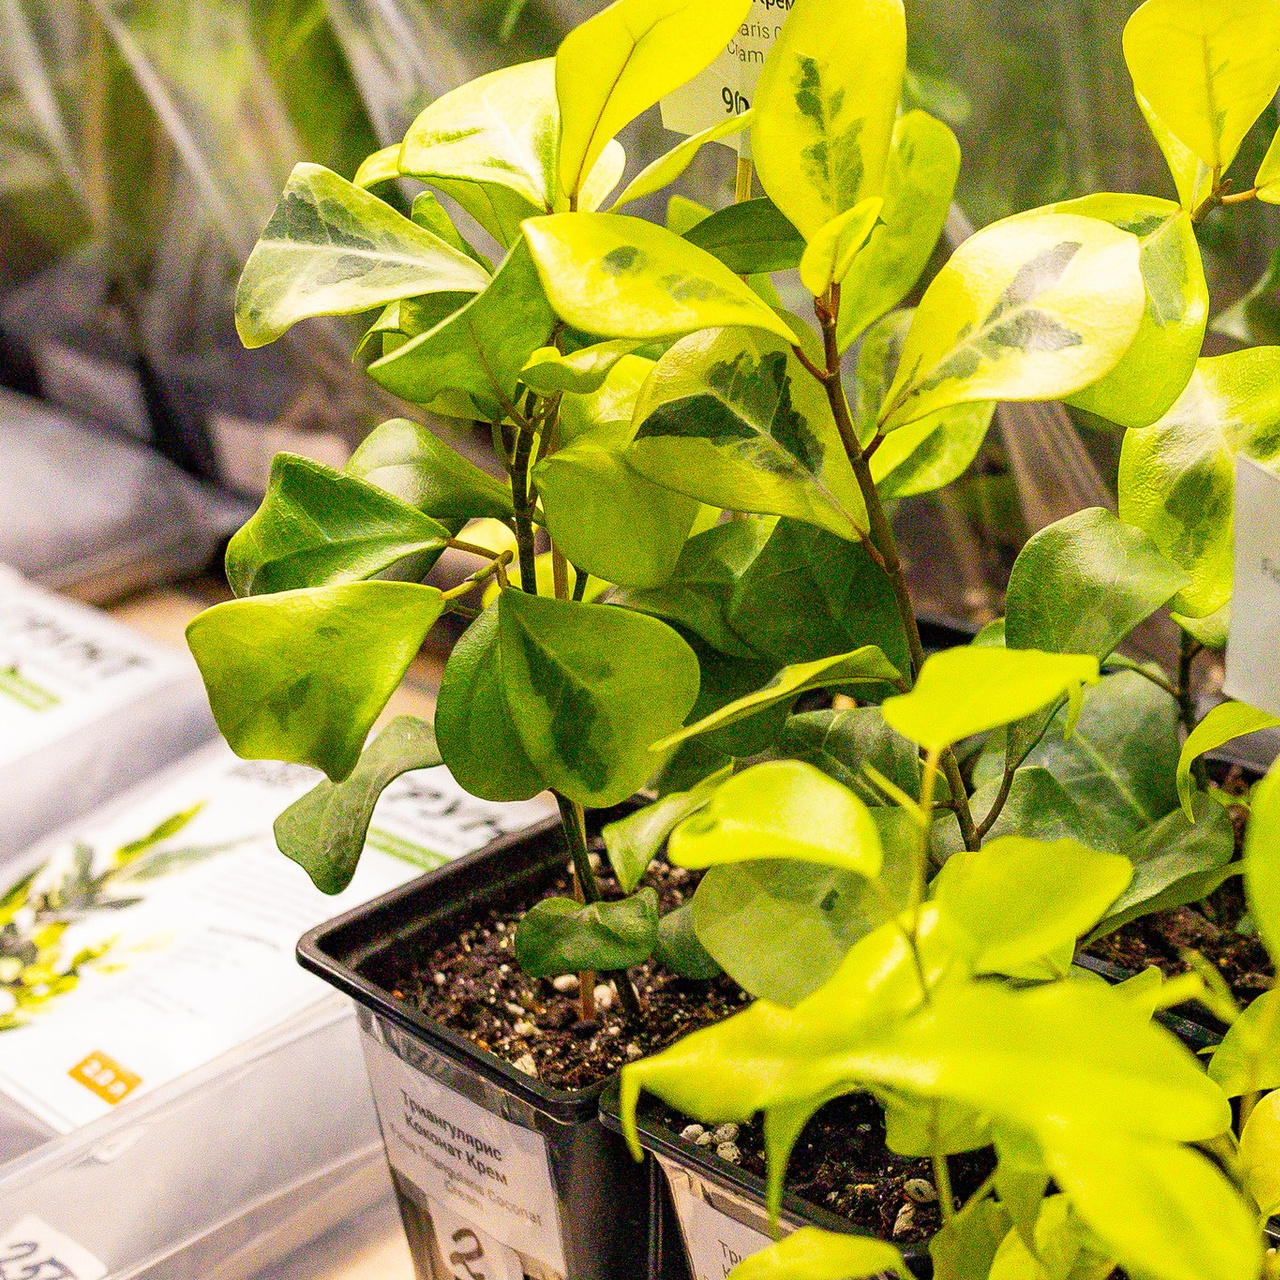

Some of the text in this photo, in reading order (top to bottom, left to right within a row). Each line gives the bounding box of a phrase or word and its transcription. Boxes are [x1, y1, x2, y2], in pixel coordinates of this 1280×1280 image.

[401, 1089, 502, 1161] Триангулярис
[405, 1112, 508, 1186] Коконат Крем
